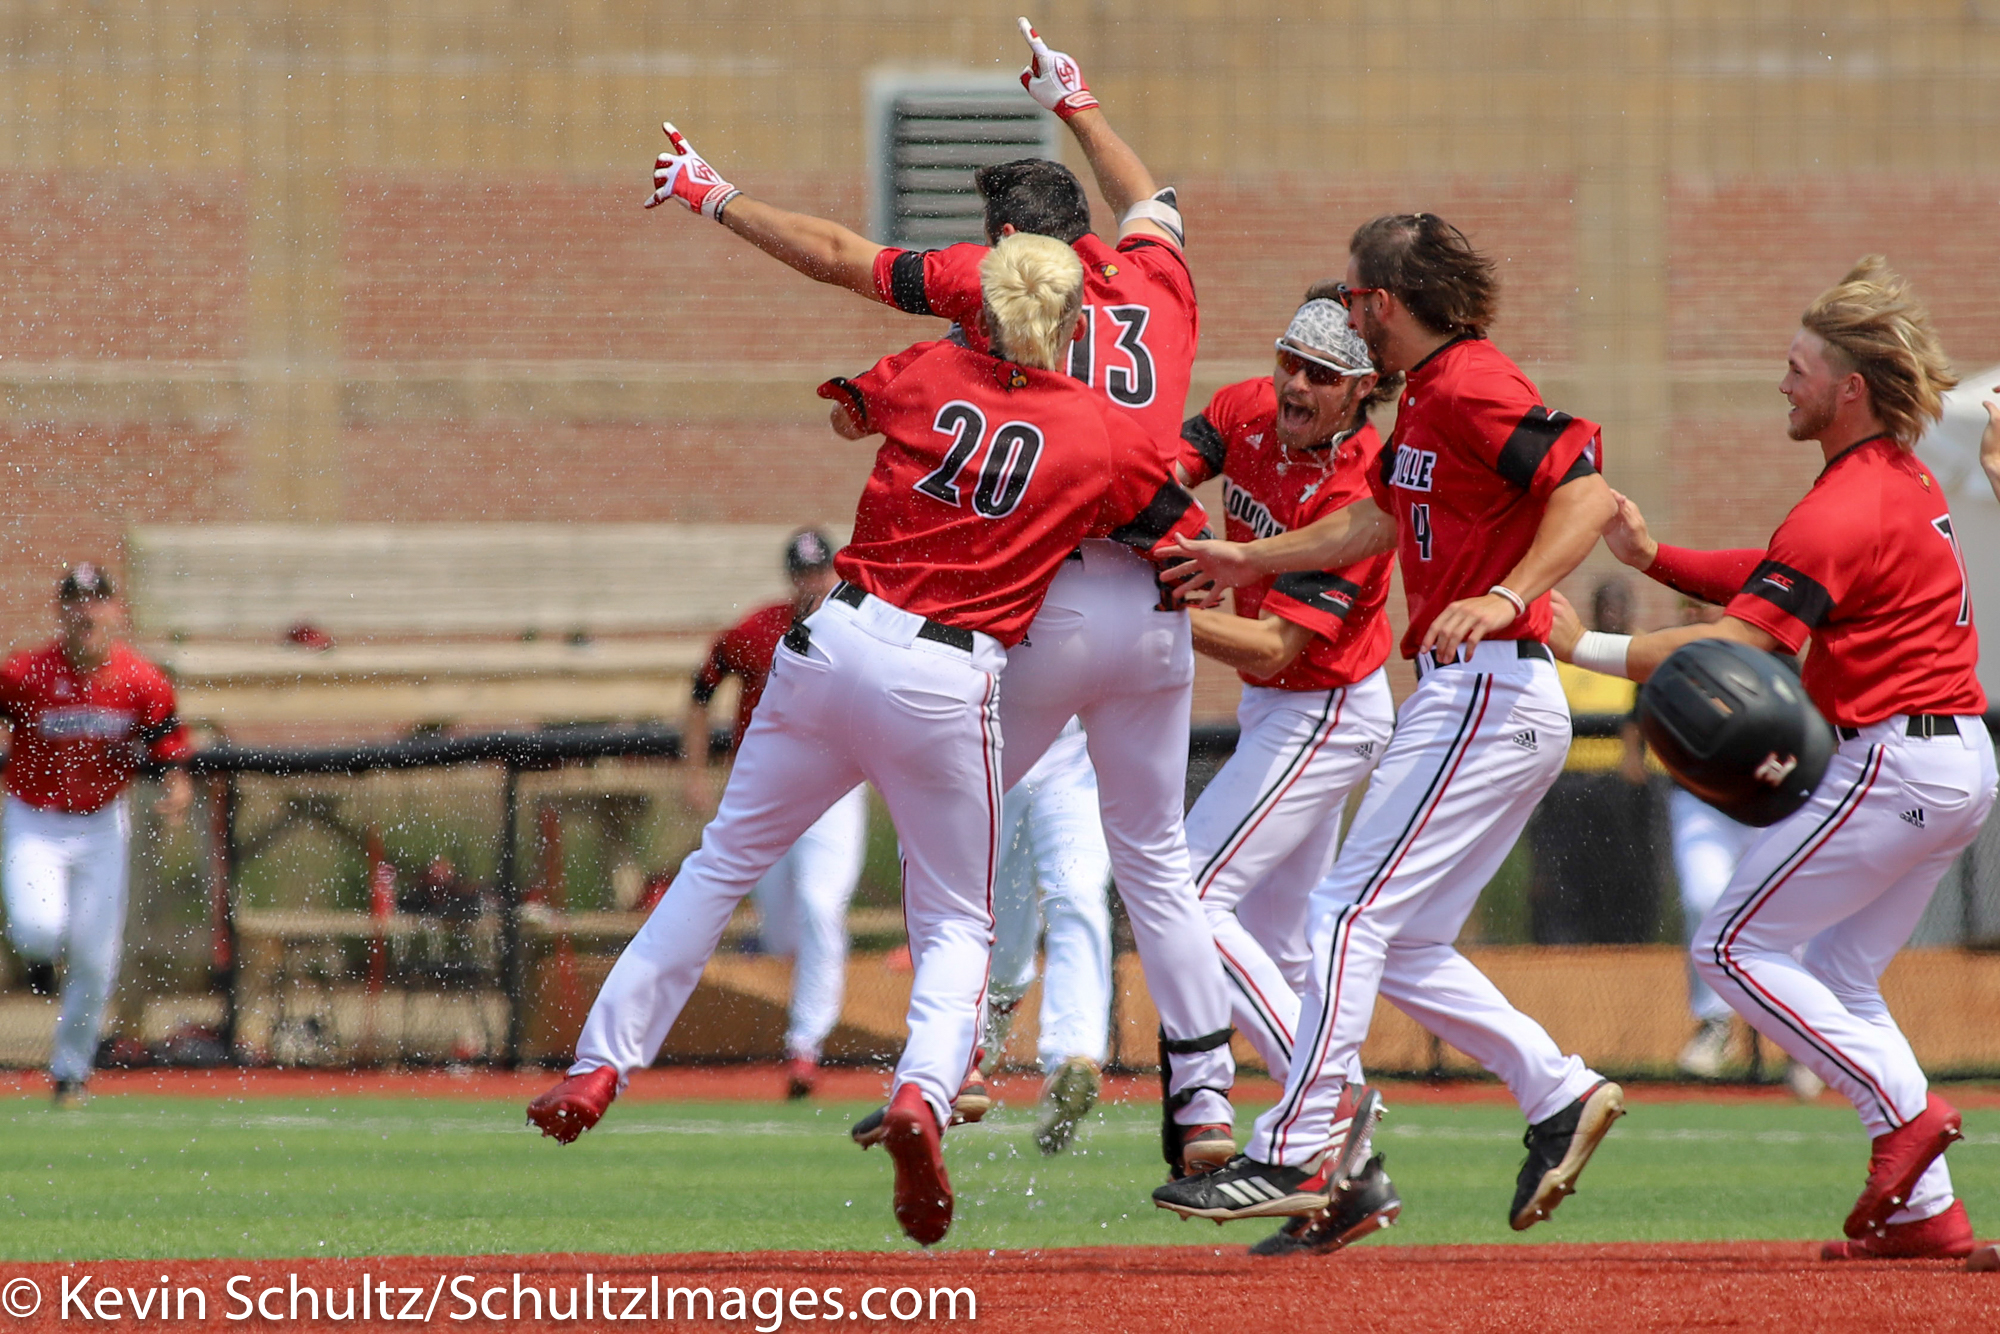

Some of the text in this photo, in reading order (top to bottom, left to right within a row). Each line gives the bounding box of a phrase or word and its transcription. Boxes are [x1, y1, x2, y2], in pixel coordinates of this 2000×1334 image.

[1066, 303, 1157, 409] 13
[912, 399, 1045, 520] 20
[1411, 501, 1434, 562] 4
[1322, 589, 1353, 605] ACC
[1512, 735, 1539, 751] adidas
[1899, 812, 1926, 829] adidas
